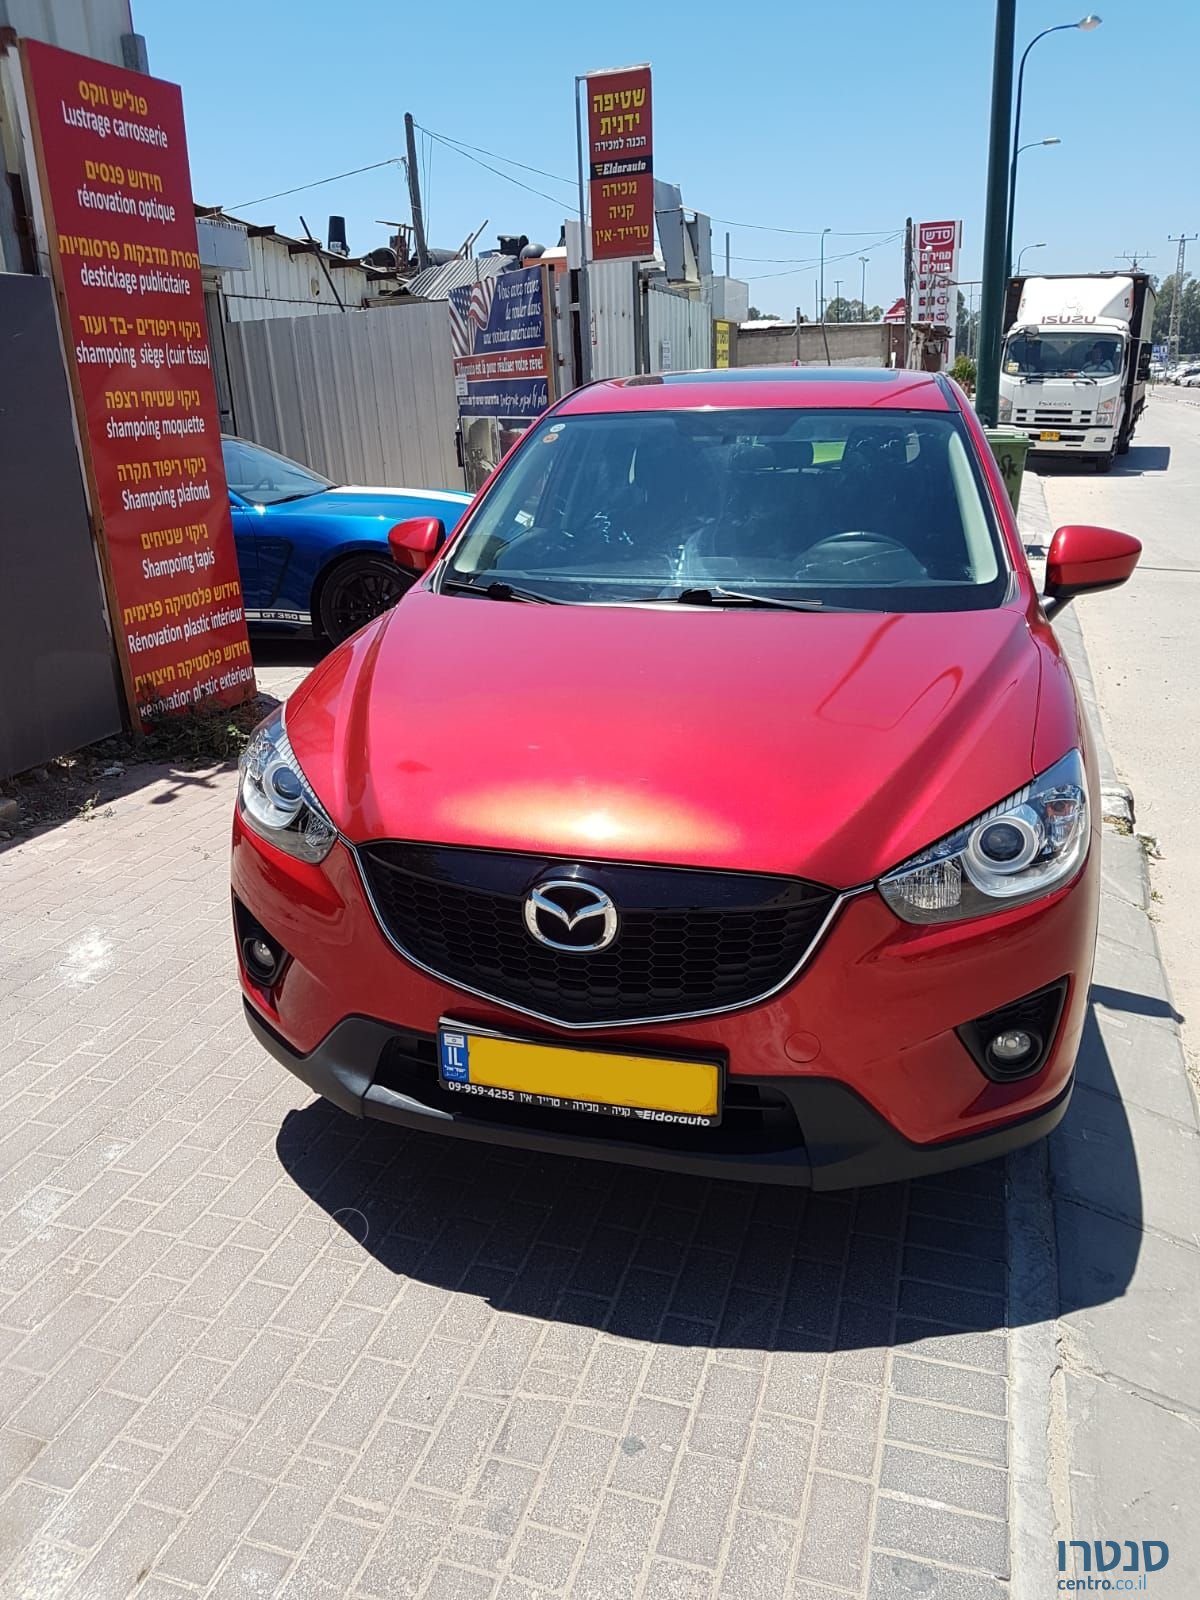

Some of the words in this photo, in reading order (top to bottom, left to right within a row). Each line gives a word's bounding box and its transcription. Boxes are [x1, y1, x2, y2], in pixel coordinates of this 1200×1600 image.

[80, 80, 109, 106] ווקס
[111, 89, 148, 116] פוליש
[593, 87, 646, 113] שטיפה
[61, 100, 111, 138] Lustrage
[113, 117, 168, 148] carrosserie
[600, 113, 640, 136] ידנית
[595, 137, 624, 153] למכירה
[626, 135, 647, 147] הכנה
[85, 159, 125, 185] פנסים
[602, 160, 647, 175] Eldorauto
[127, 168, 163, 192] חידוש
[602, 181, 637, 198] מכירה
[77, 183, 136, 216] rénovation
[139, 193, 175, 223] optique
[609, 203, 635, 220] קניה
[595, 224, 650, 247] טרייד-אין
[925, 229, 950, 241] סדש
[58, 234, 120, 260] פרסומיות
[124, 244, 169, 267] מדבקות
[921, 251, 951, 261] מחירם
[170, 253, 200, 270] הסרת
[80, 263, 138, 293] destickage
[140, 270, 191, 296] publicitaire
[79, 314, 108, 335] ועור
[137, 318, 177, 337] ריפודים
[179, 320, 201, 341] ניקוי
[1041, 315, 1096, 324] ISUZU
[76, 341, 135, 368] shampoing
[140, 343, 164, 368] siège
[165, 342, 186, 369] (cuir
[187, 344, 210, 369] tissu)
[105, 390, 139, 410] רצפה
[140, 390, 175, 409] שטיחי
[177, 389, 201, 410] ניקוי
[106, 417, 161, 442] shampoing
[163, 415, 205, 438] moquette
[117, 462, 151, 484] תקרה
[153, 458, 182, 478] ריפוד
[183, 455, 207, 478] ניקוי
[121, 485, 177, 512] Shampoing
[177, 479, 210, 507] plafond
[140, 526, 183, 550] שטיחים
[185, 522, 209, 545] ניקוי
[142, 551, 194, 579] Shampoing
[194, 547, 215, 572] tapis
[165, 588, 212, 616] פלסטיקה
[213, 580, 240, 602] חידוש
[123, 601, 163, 626] פנימית
[128, 620, 182, 654] Rénovation
[183, 616, 210, 643] plastic
[210, 606, 243, 630] intérieur
[223, 638, 250, 662] חידוש
[177, 650, 222, 680] פלסטיקה
[219, 664, 254, 691] extérieur
[448, 1046, 463, 1066] IL
[448, 1081, 515, 1101] 09-959-4255
[519, 1092, 533, 1105] אין
[572, 1100, 599, 1113] מכירה
[611, 1106, 631, 1118] קניה
[642, 1109, 711, 1128] Eldorauto
